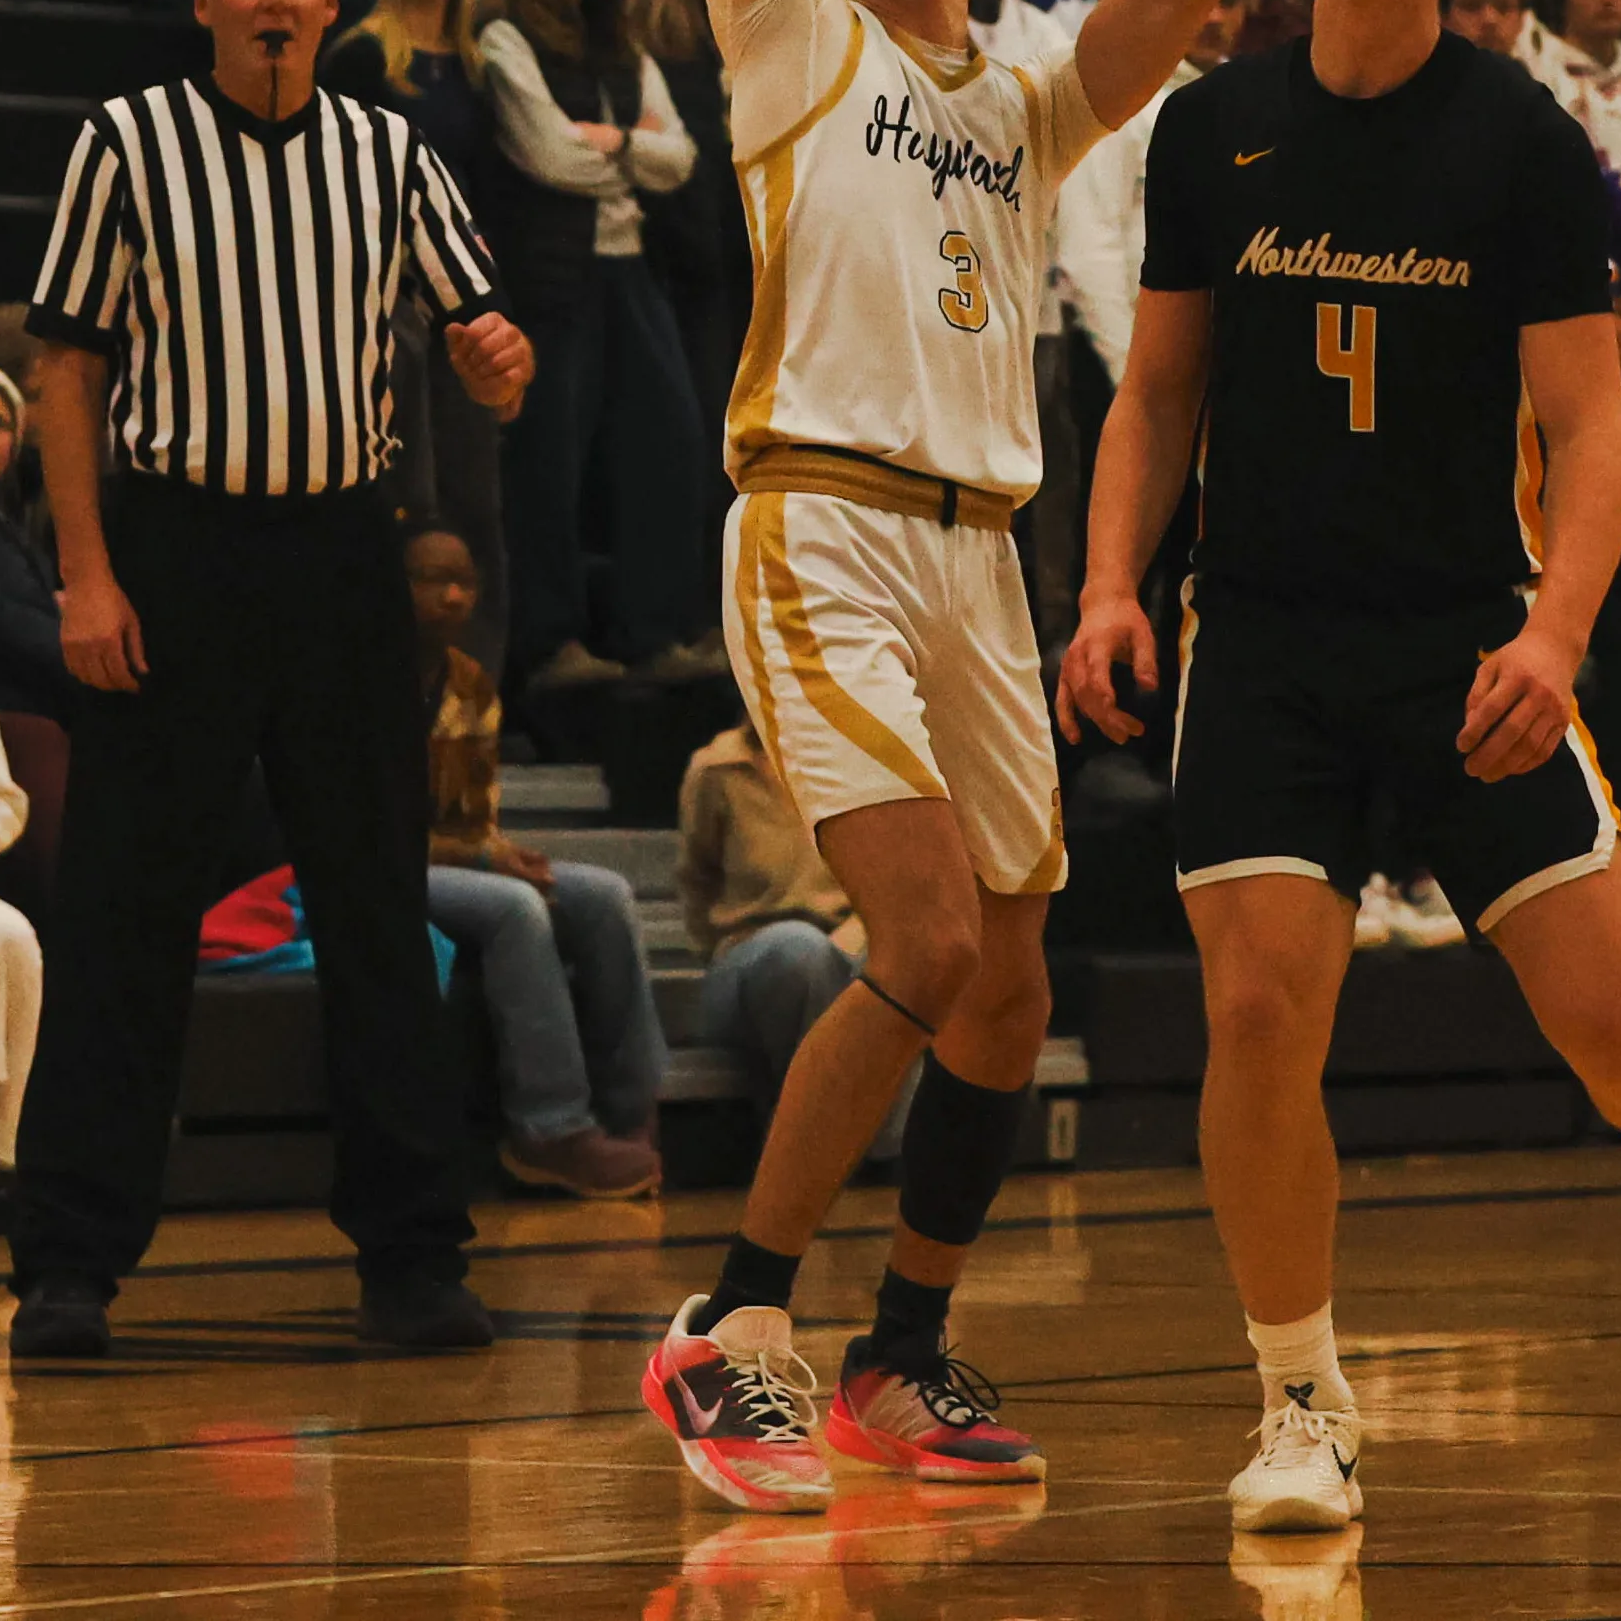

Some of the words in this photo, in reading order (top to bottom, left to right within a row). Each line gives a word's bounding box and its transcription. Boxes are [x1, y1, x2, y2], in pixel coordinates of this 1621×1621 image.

[866, 94, 1024, 212] Hayward
[938, 230, 989, 334] 3
[1235, 226, 1471, 288] Northwestern
[1316, 302, 1377, 433] 4
